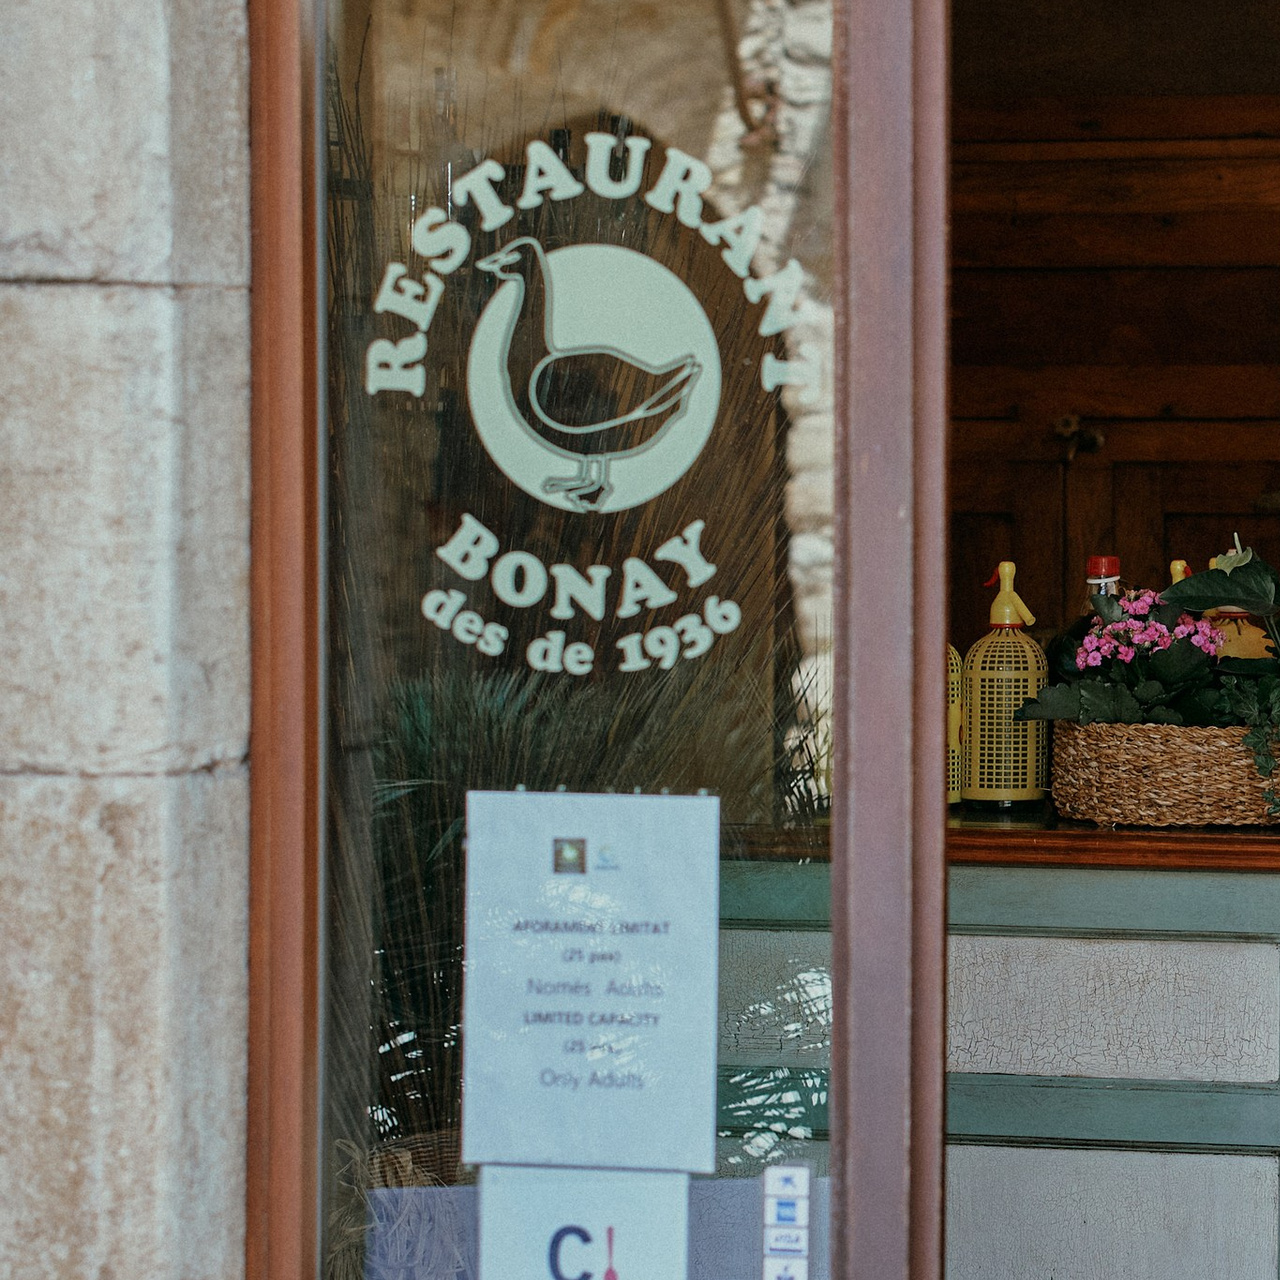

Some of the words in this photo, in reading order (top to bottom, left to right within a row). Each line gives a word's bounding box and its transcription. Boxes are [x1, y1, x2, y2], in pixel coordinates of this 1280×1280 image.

[365, 132, 825, 397] RESTAURANT
[435, 513, 717, 621] BONAY
[421, 588, 509, 656] des
[526, 631, 594, 675] de
[616, 596, 741, 672] 1936
